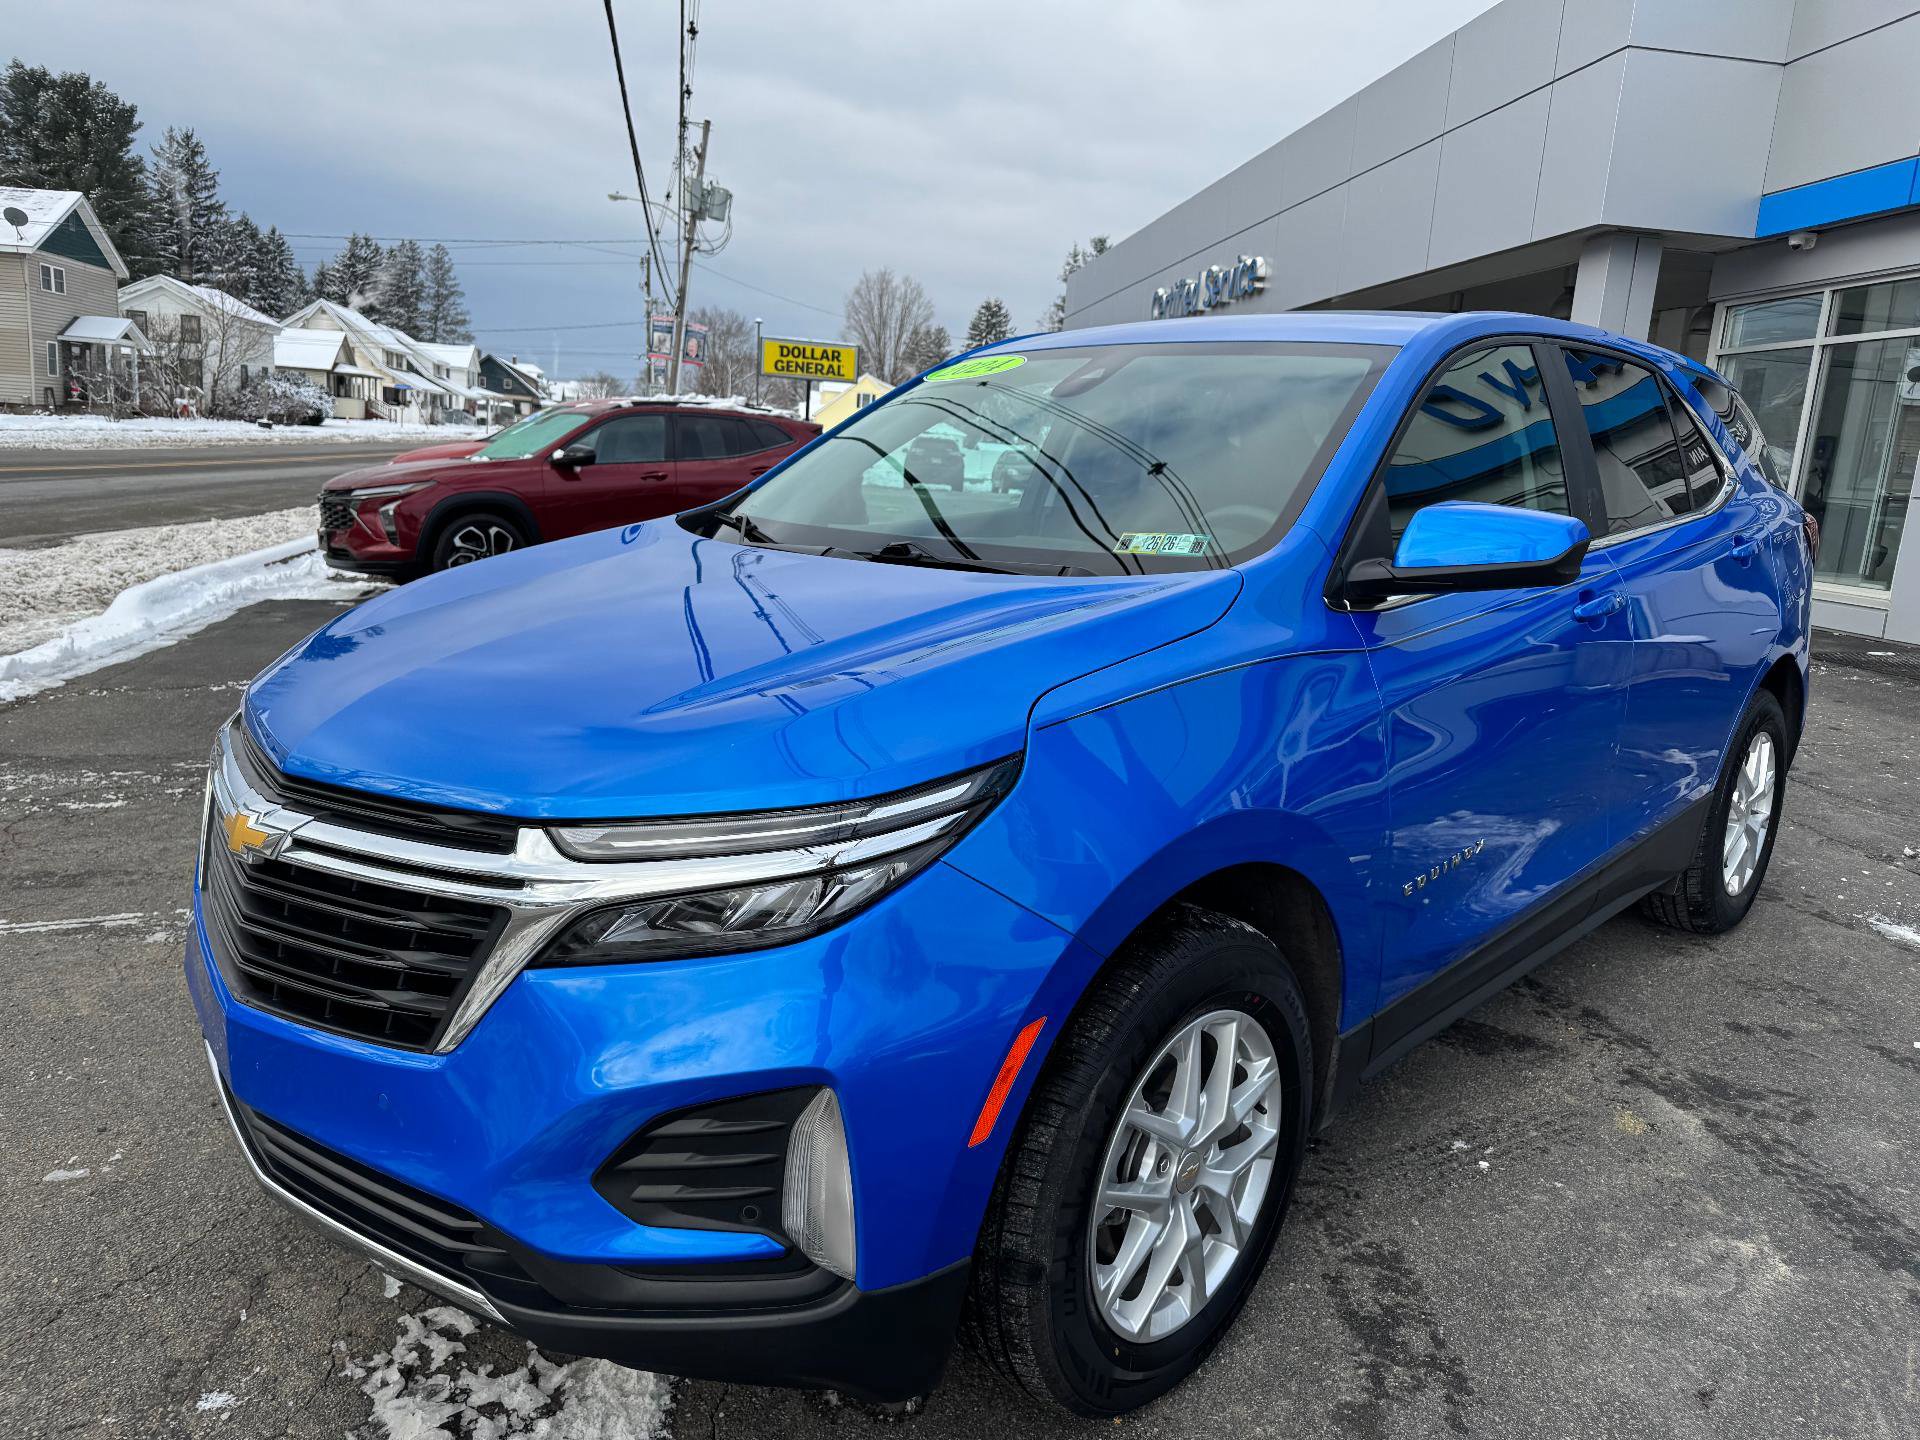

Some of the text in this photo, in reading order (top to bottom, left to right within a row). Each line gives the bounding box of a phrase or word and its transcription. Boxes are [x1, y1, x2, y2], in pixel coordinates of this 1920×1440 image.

[1203, 255, 1266, 308] Service
[774, 359, 845, 377] GENERAL
[778, 345, 842, 362] DOLLAR
[1402, 838, 1485, 897] EQUINOX
